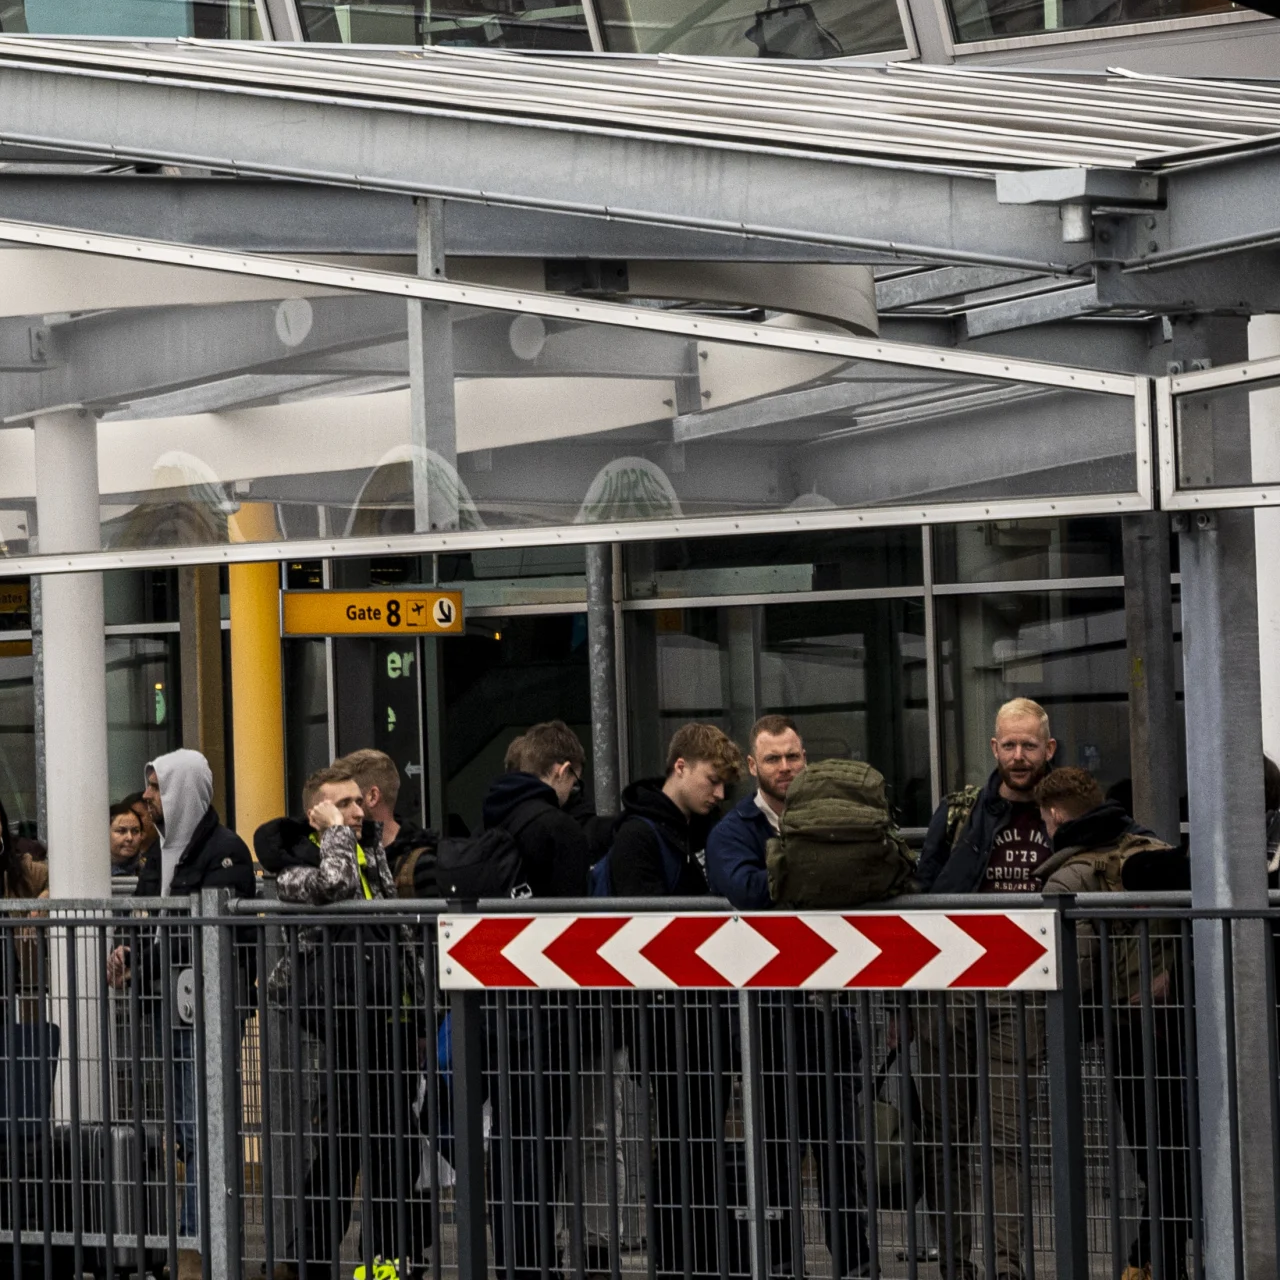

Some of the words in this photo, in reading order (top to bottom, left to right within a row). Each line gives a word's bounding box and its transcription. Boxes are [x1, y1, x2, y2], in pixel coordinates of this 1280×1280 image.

[346, 605, 381, 620] Gate
[386, 600, 401, 627] 8
[986, 866, 1030, 880] CRUDE
